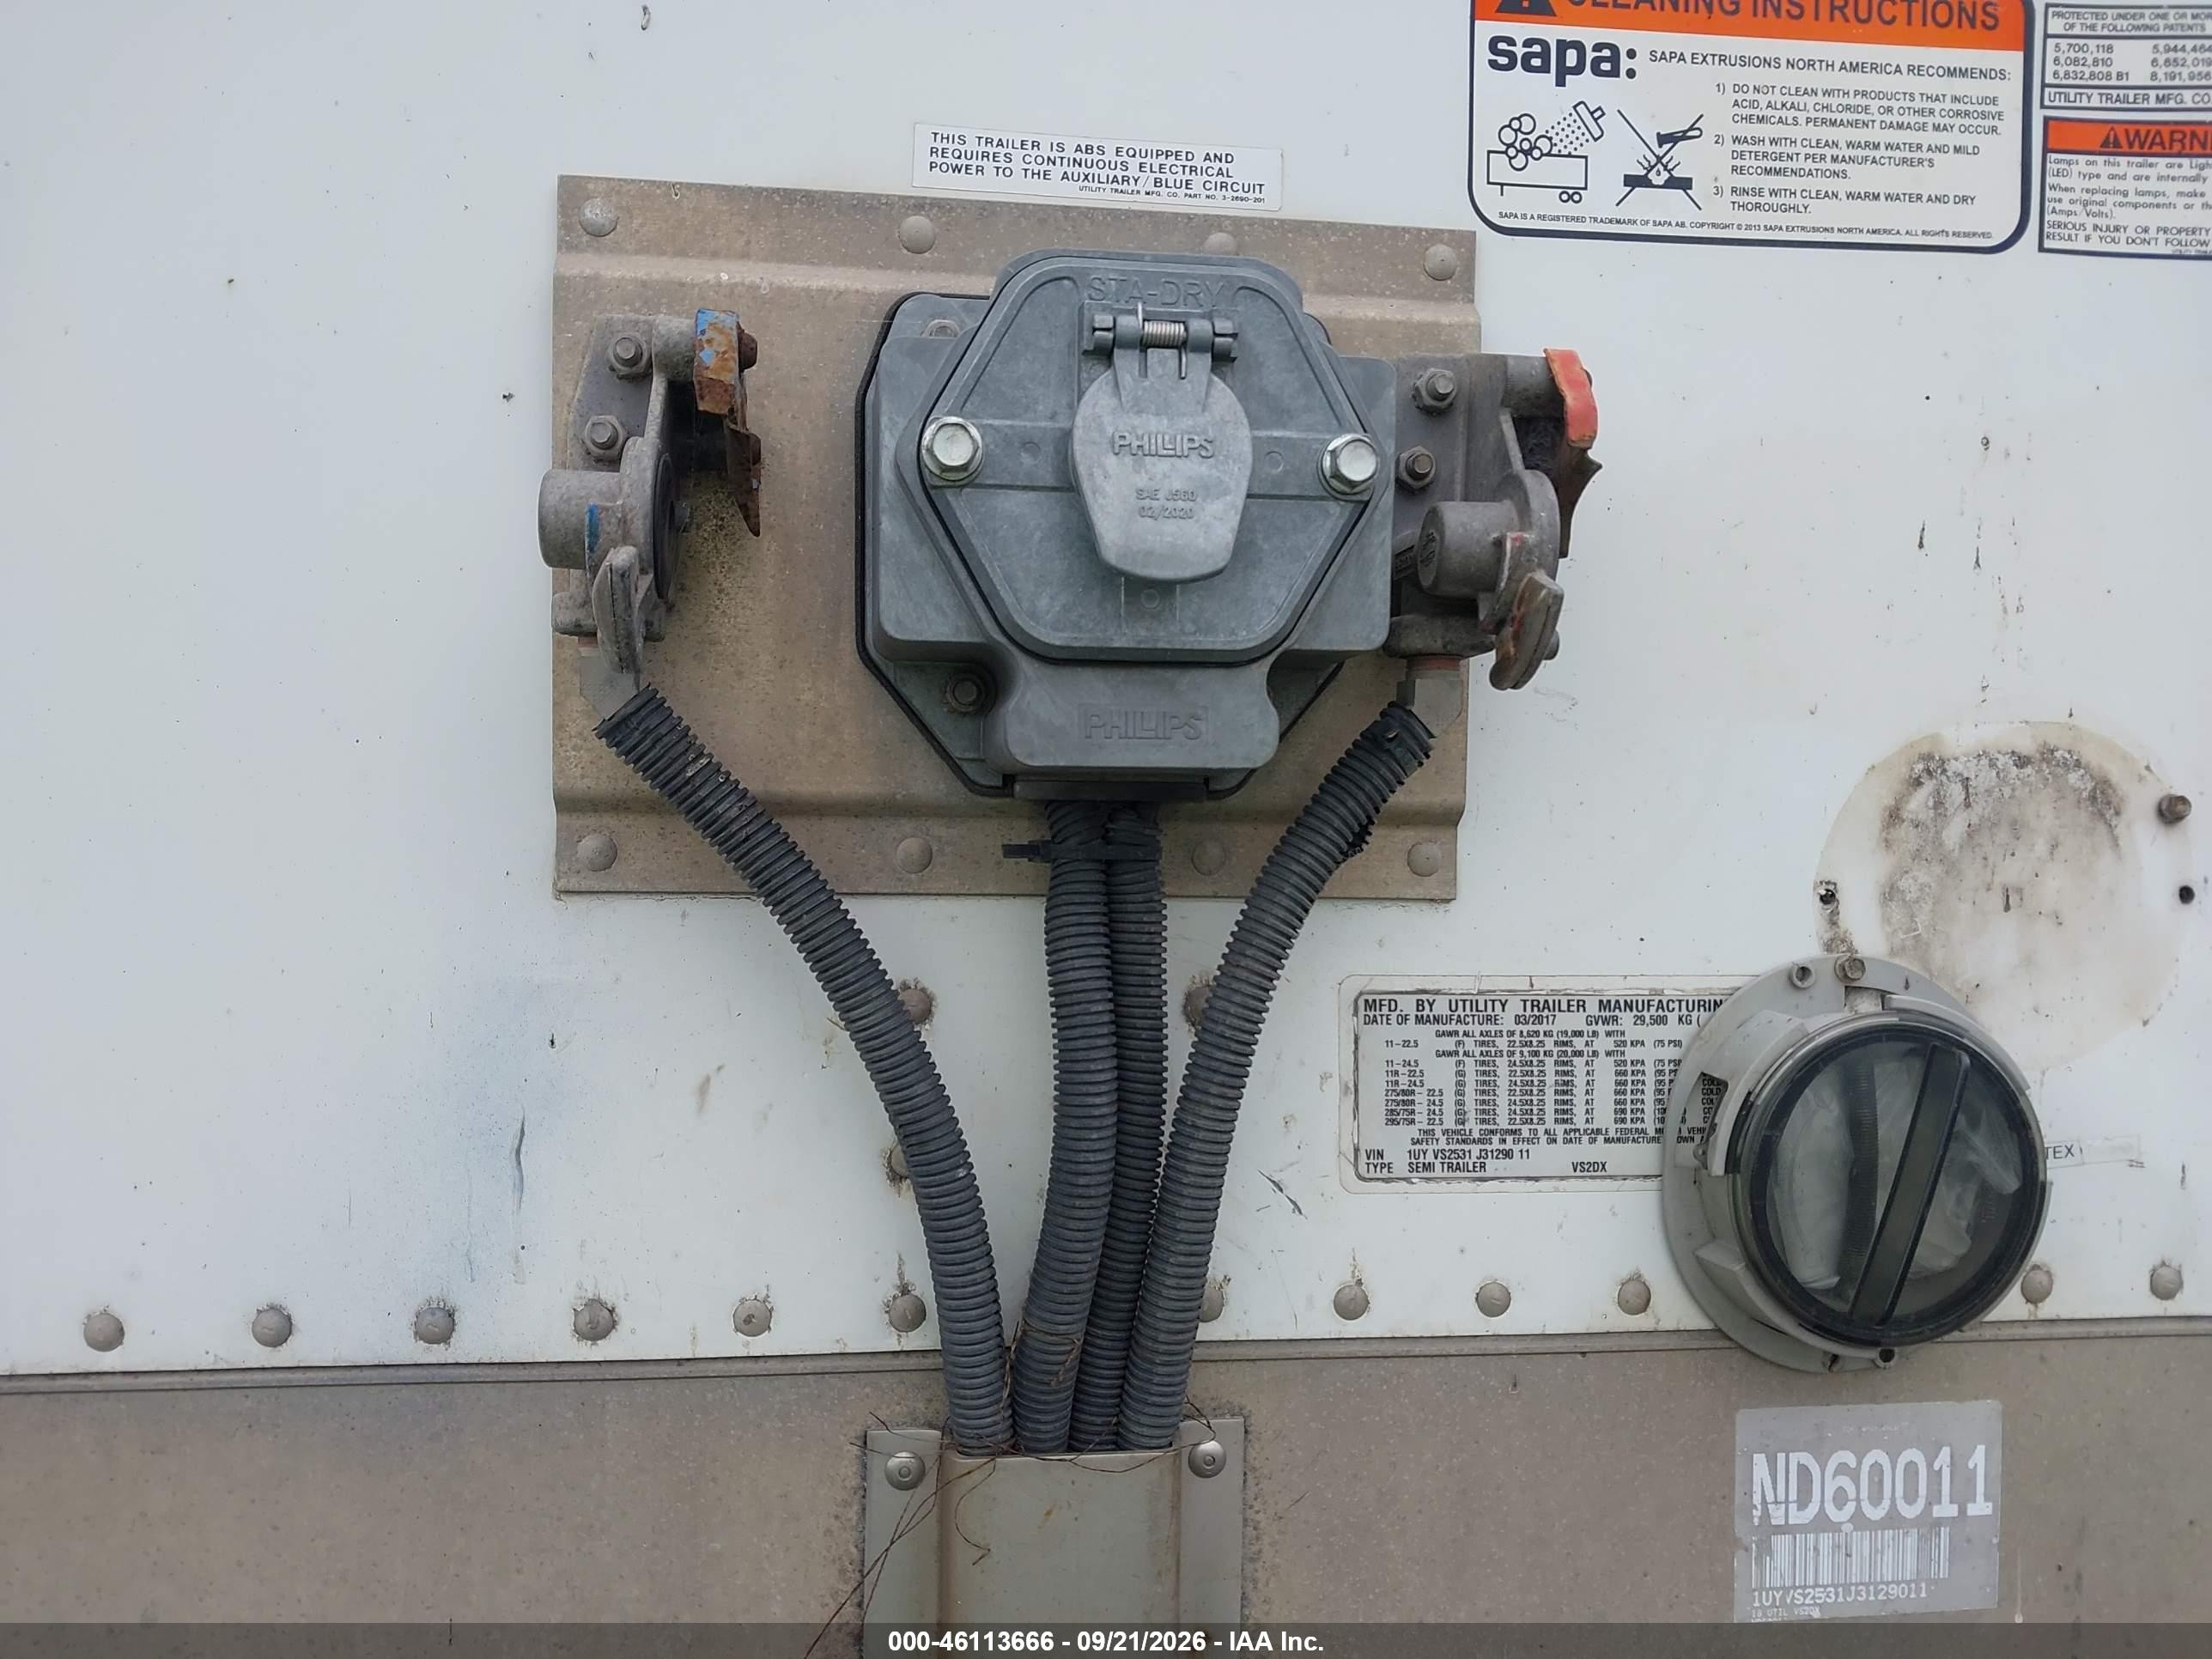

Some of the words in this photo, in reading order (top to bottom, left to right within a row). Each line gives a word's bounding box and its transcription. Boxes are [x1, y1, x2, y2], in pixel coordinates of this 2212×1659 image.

[1753, 0, 2000, 31] INSTRUCTIONS
[2063, 21, 2076, 31] OF
[2079, 21, 2098, 32] THE
[2100, 22, 2160, 32] FOLLOWING
[2162, 22, 2205, 32] PATENTS
[2053, 42, 2113, 54] 5,700,118
[1488, 36, 1637, 88] sapa:
[1649, 49, 1686, 64] SAPA
[1690, 52, 1781, 69] EXTRUSIONS
[1785, 58, 1834, 71] NORTH
[1838, 61, 1903, 75] AMERICA
[1906, 64, 2010, 80] RECOMMENDS:
[2052, 55, 2112, 67] 6,082,810
[2052, 70, 2112, 81] 6,832,808
[2115, 70, 2129, 81] B1
[2149, 70, 2212, 82] 8,191,956
[1715, 82, 1725, 95] 1)
[1732, 82, 1749, 94] DO
[1752, 84, 1777, 94] NOT
[1779, 85, 1818, 96] CLEAN
[1820, 88, 1850, 98] WITH
[1853, 89, 1915, 101] PRODUCTS
[1918, 92, 1947, 103] THAT
[1950, 94, 1999, 106] INCLUDE
[2048, 91, 2094, 103] UTILITY
[2097, 92, 2150, 104] TRAILER
[2154, 92, 2187, 104] MFG.
[1731, 98, 1762, 111] ACID,
[1765, 100, 1809, 112] ALKALI,
[1813, 102, 1874, 115] CHLORIDE,
[1876, 105, 1893, 115] OR
[1897, 106, 1936, 117] OTHER
[1938, 108, 2004, 120] CORROSIVE
[1731, 113, 1802, 126] CHEMICALS.
[1805, 116, 1876, 129] PERMANENT
[1879, 119, 1929, 131] DAMAGE
[1932, 122, 1955, 132] MAY
[1958, 123, 2001, 135] OCCUR.
[930, 131, 966, 145] THIS
[975, 136, 1040, 150] TRAILER
[1049, 141, 1065, 153] IS
[1073, 143, 1105, 155] ABS
[1115, 146, 1194, 161] EQUIPPED
[1202, 152, 1234, 163] AND
[1713, 134, 1724, 146] 2)
[1730, 135, 1765, 146] WASH
[1768, 137, 1796, 147] WITH
[1800, 137, 1842, 149] CLEAN,
[1844, 140, 1881, 150] WARM
[1883, 142, 1923, 152] WATER
[1925, 143, 1950, 154] AND
[1953, 144, 1979, 155] MILD
[929, 146, 1012, 163] REQUIRES
[1022, 154, 1128, 171] CONTINUOUS
[1138, 161, 1233, 178] ELECTRICAL
[1731, 149, 1801, 161] DETERGENT
[1803, 152, 1826, 163] PER
[1830, 154, 1934, 167] MANUFACTURER'S
[929, 161, 984, 175] POWER
[993, 166, 1013, 177] TO
[1020, 167, 1051, 180] THE
[1202, 179, 1265, 194] CIRCUIT
[1730, 165, 1850, 179] RECOMMENDATIONS.
[1221, 194, 1265, 203] 3-2690-201
[1712, 185, 1723, 198] 3)
[1730, 185, 1765, 197] RINSE
[1767, 187, 1796, 198] WITH
[1800, 188, 1841, 200] CLEAN,
[1844, 191, 1881, 201] WARM
[1883, 191, 1923, 203] WATER
[1925, 193, 1950, 204] AND
[1953, 194, 1976, 204] DRY
[1729, 200, 1811, 213] THOROUGHLY.
[2046, 220, 2087, 231] SERIOUS
[2092, 223, 2129, 234] INJURY
[2134, 225, 2150, 234] OR
[2155, 226, 2210, 236] PROPERTY
[2045, 231, 2079, 241] RESULT
[2084, 234, 2092, 242] IF
[2098, 234, 2120, 244] YOU
[2125, 235, 2159, 246] DON'T
[2164, 237, 2210, 247] FOLLOW
[1087, 276, 1225, 307] STA-DRY
[1112, 431, 1214, 459] PHILLIPS
[1135, 489, 1160, 501] SAE
[1164, 489, 1197, 502] J560
[1085, 710, 1203, 740] PHILLIPS
[1363, 998, 1403, 1012] MFD.
[1415, 998, 1436, 1012] BY
[1448, 999, 1508, 1012] UTILITY
[1519, 999, 1586, 1012] TRAILER
[1363, 1013, 1392, 1025] DATE
[1395, 1013, 1410, 1025] OF
[1414, 1013, 1504, 1025] MANUFACTURE:
[1514, 1013, 1556, 1025] 03/2017
[1585, 1014, 1622, 1026] GVWR:
[1632, 1014, 1668, 1026] 29,500
[1677, 1013, 1692, 1025] KG
[1434, 1029, 1460, 1037] GAWR
[1461, 1029, 1476, 1037] ALL
[1478, 1029, 1504, 1037] AXLES
[1505, 1029, 1516, 1038] OF
[1518, 1029, 1540, 1038] 8,620
[1542, 1029, 1553, 1037] KG
[1556, 1029, 1584, 1039] (19,000
[1586, 1029, 1599, 1038] LB)
[1454, 1039, 1465, 1049] (F)
[1473, 1039, 1498, 1048] TIRES,
[1506, 1039, 1546, 1048] 22.5X8.25
[1553, 1039, 1576, 1048] RIMS,
[1583, 1039, 1594, 1048] AT
[1613, 1039, 1627, 1048] 520
[1629, 1039, 1645, 1048] KPA
[1653, 1039, 1665, 1048] (75
[1667, 1039, 1682, 1048] PSI)
[1364, 1148, 1383, 1160] VIN
[1407, 1148, 1428, 1160] 1UY
[1431, 1148, 1471, 1160] VS2531
[1475, 1148, 1514, 1160] J31290
[1517, 1148, 1529, 1159] 11
[2045, 1144, 2075, 1159] TEX
[1364, 1162, 1393, 1173] TYPE
[1407, 1161, 1435, 1173] SEMI
[1438, 1161, 1486, 1172] TRAILER
[1571, 1161, 1607, 1172] VS2DX
[1753, 1444, 1992, 1525] ND60011
